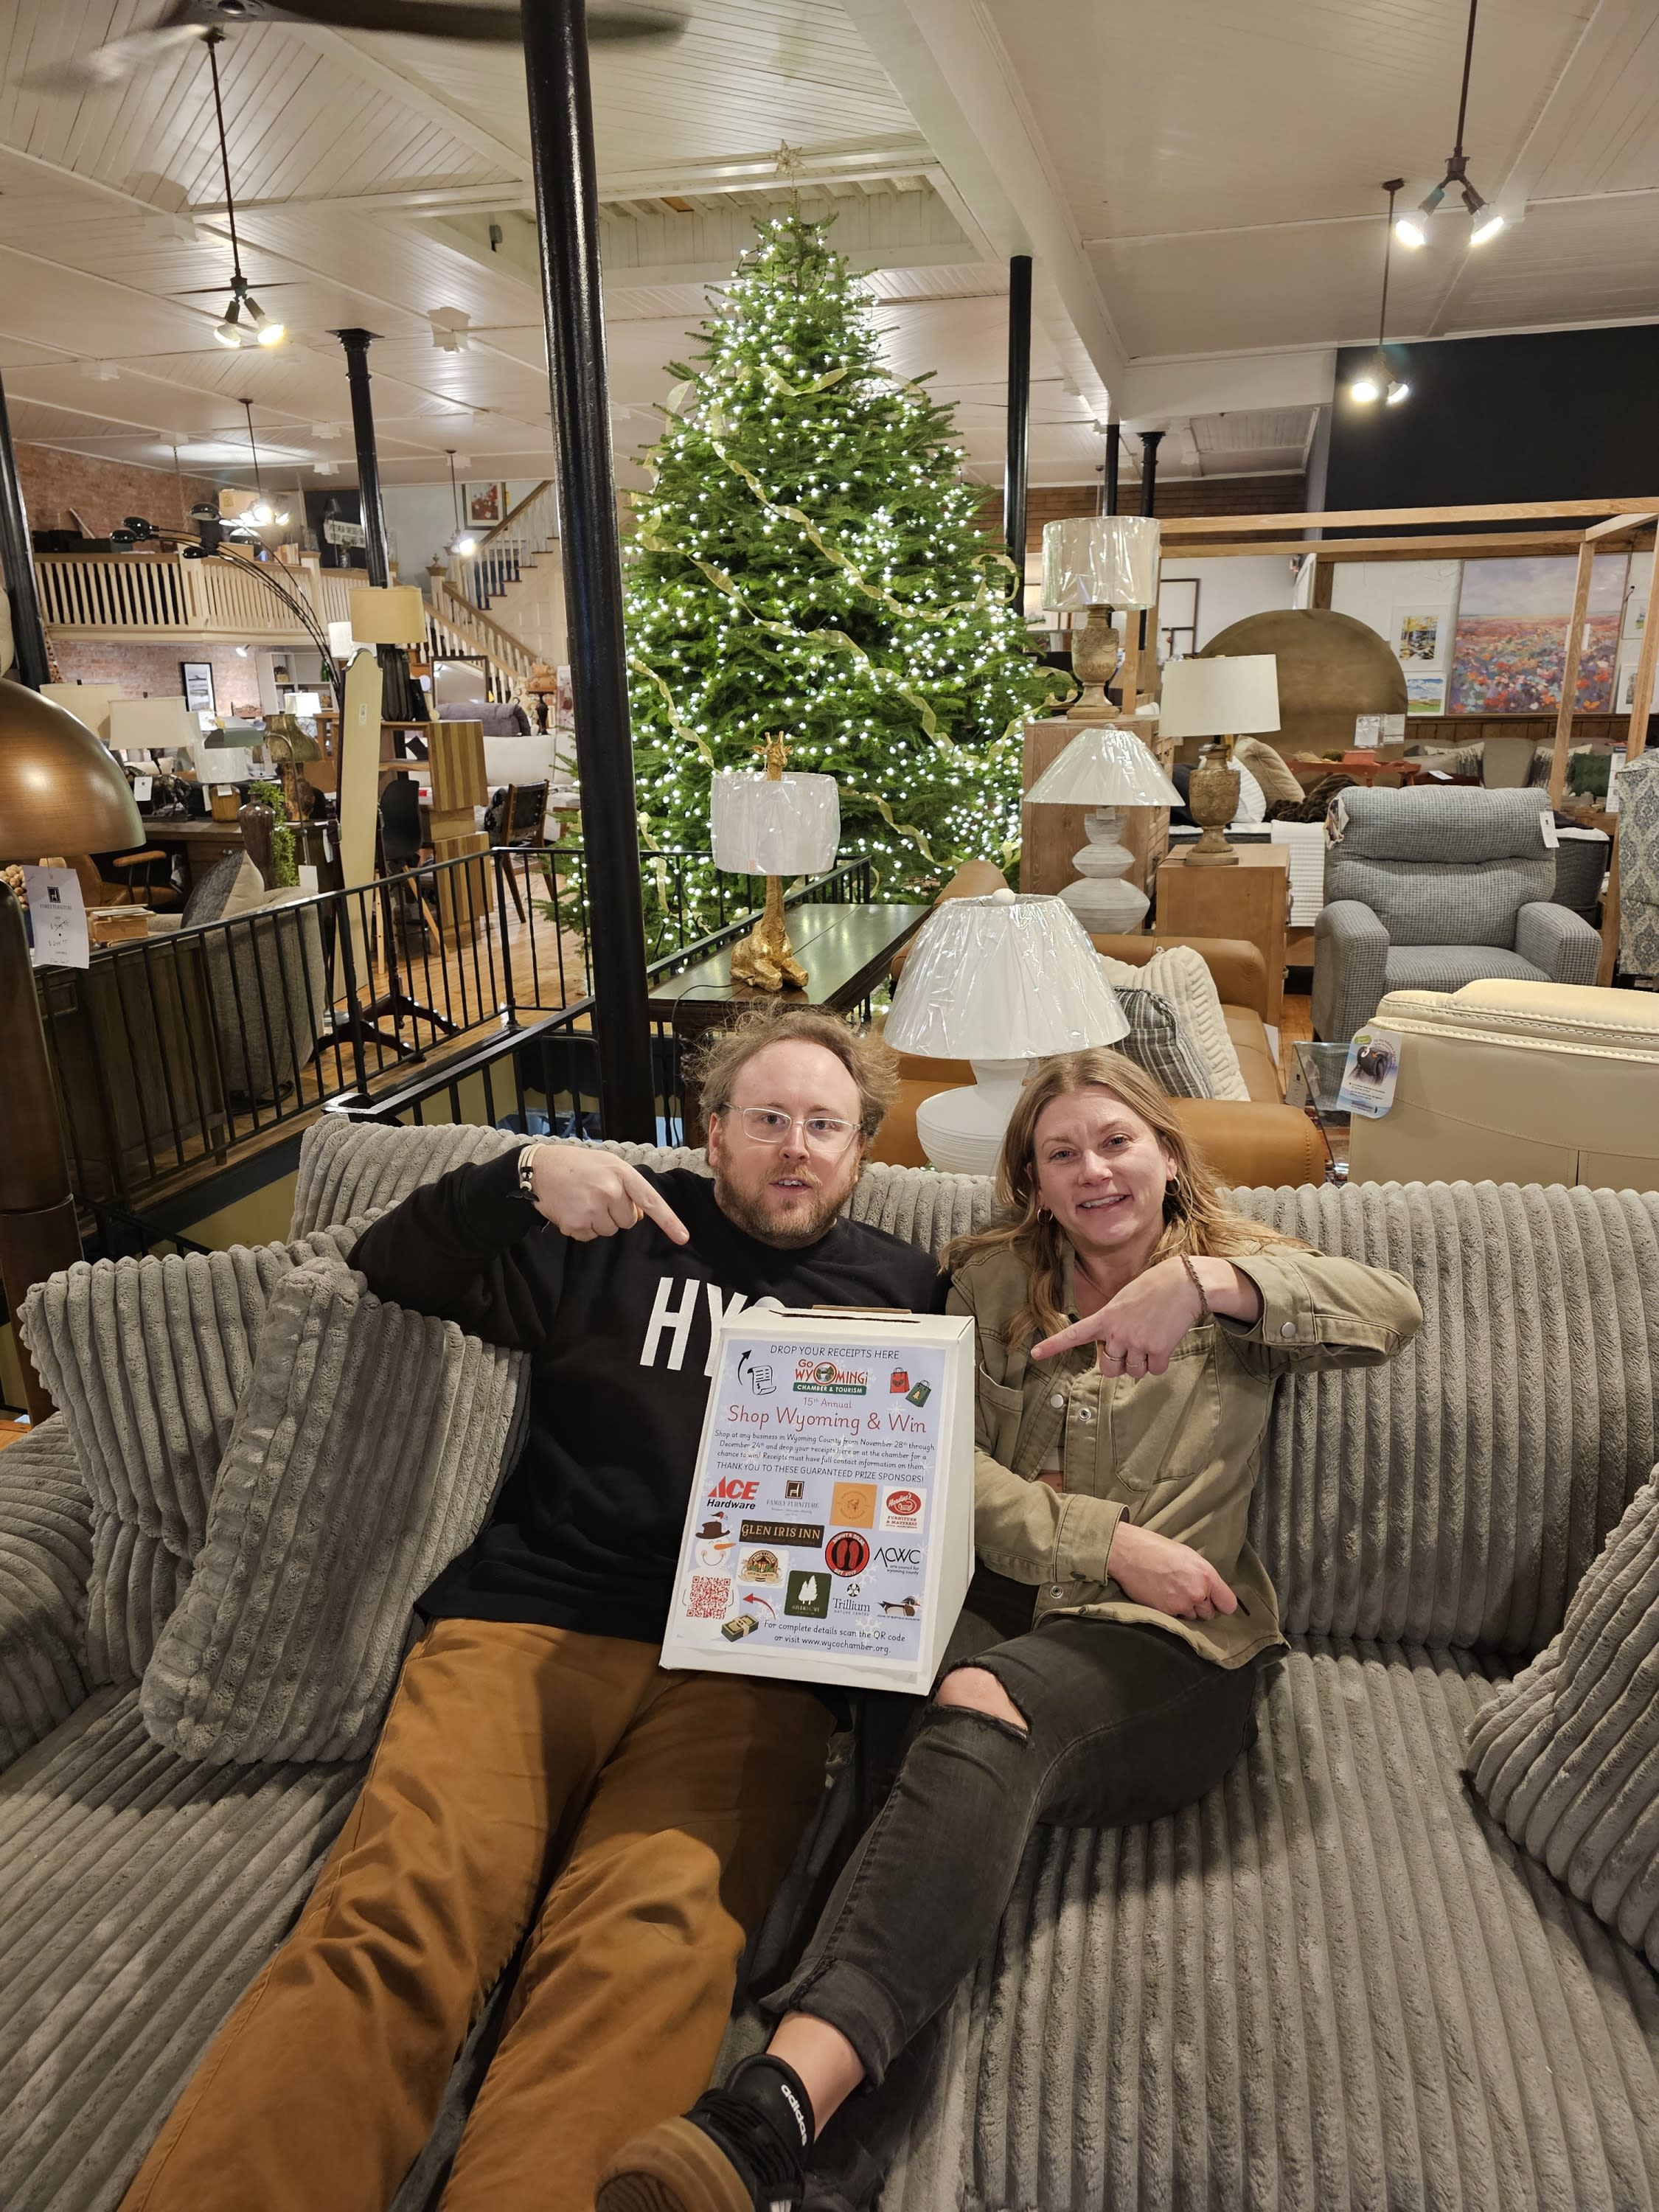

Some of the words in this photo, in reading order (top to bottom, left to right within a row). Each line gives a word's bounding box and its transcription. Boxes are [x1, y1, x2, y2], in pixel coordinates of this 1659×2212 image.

[639, 1276, 786, 1377] HY
[771, 1345, 797, 1355] DROP
[799, 1346, 825, 1357] YOUR
[827, 1348, 872, 1359] RECEIPTS
[874, 1350, 900, 1360] HERE
[796, 1384, 827, 1392] CHAMBER
[835, 1386, 863, 1394] TOURISM
[821, 1398, 852, 1409] Annual
[727, 1404, 769, 1430] Shop
[776, 1406, 860, 1436] Wyoming
[867, 1411, 880, 1430] &
[888, 1413, 927, 1433] Win
[714, 1430, 731, 1439] Shop
[752, 1432, 778, 1440] business
[787, 1433, 816, 1444] Wyoming
[818, 1435, 841, 1446] County
[842, 1436, 858, 1447] from
[860, 1439, 892, 1448] November
[908, 1442, 935, 1453] through
[720, 1440, 750, 1449] December
[779, 1443, 793, 1452] drop
[811, 1446, 835, 1455] receipts
[837, 1447, 852, 1455] here
[881, 1451, 909, 1459] chamber
[911, 1452, 921, 1461] for
[762, 1452, 787, 1461] Receipts
[821, 1455, 832, 1465] full
[833, 1458, 857, 1466] contact
[858, 1458, 897, 1468] information
[717, 1461, 743, 1470] THANK
[743, 1463, 760, 1472] YOU
[774, 1464, 800, 1474] THESE
[800, 1466, 853, 1478] GUARANTEED
[855, 1470, 877, 1480] PRIZE
[878, 1472, 925, 1484] SPONSORS!
[708, 1475, 761, 1500] ACE
[706, 1498, 756, 1510] Hardware
[787, 1500, 820, 1509] FURNITURE
[741, 1524, 772, 1537] GLEN
[773, 1526, 797, 1538] IRIS
[799, 1529, 821, 1540] INN
[874, 1547, 921, 1568] ACWC
[832, 1598, 870, 1612] Trillium
[764, 1619, 776, 1628] For
[779, 1623, 812, 1635] complete
[813, 1625, 838, 1635] details
[859, 1630, 872, 1638] the
[873, 1630, 886, 1641] QR
[888, 1632, 905, 1642] code
[785, 1635, 800, 1644] visit
